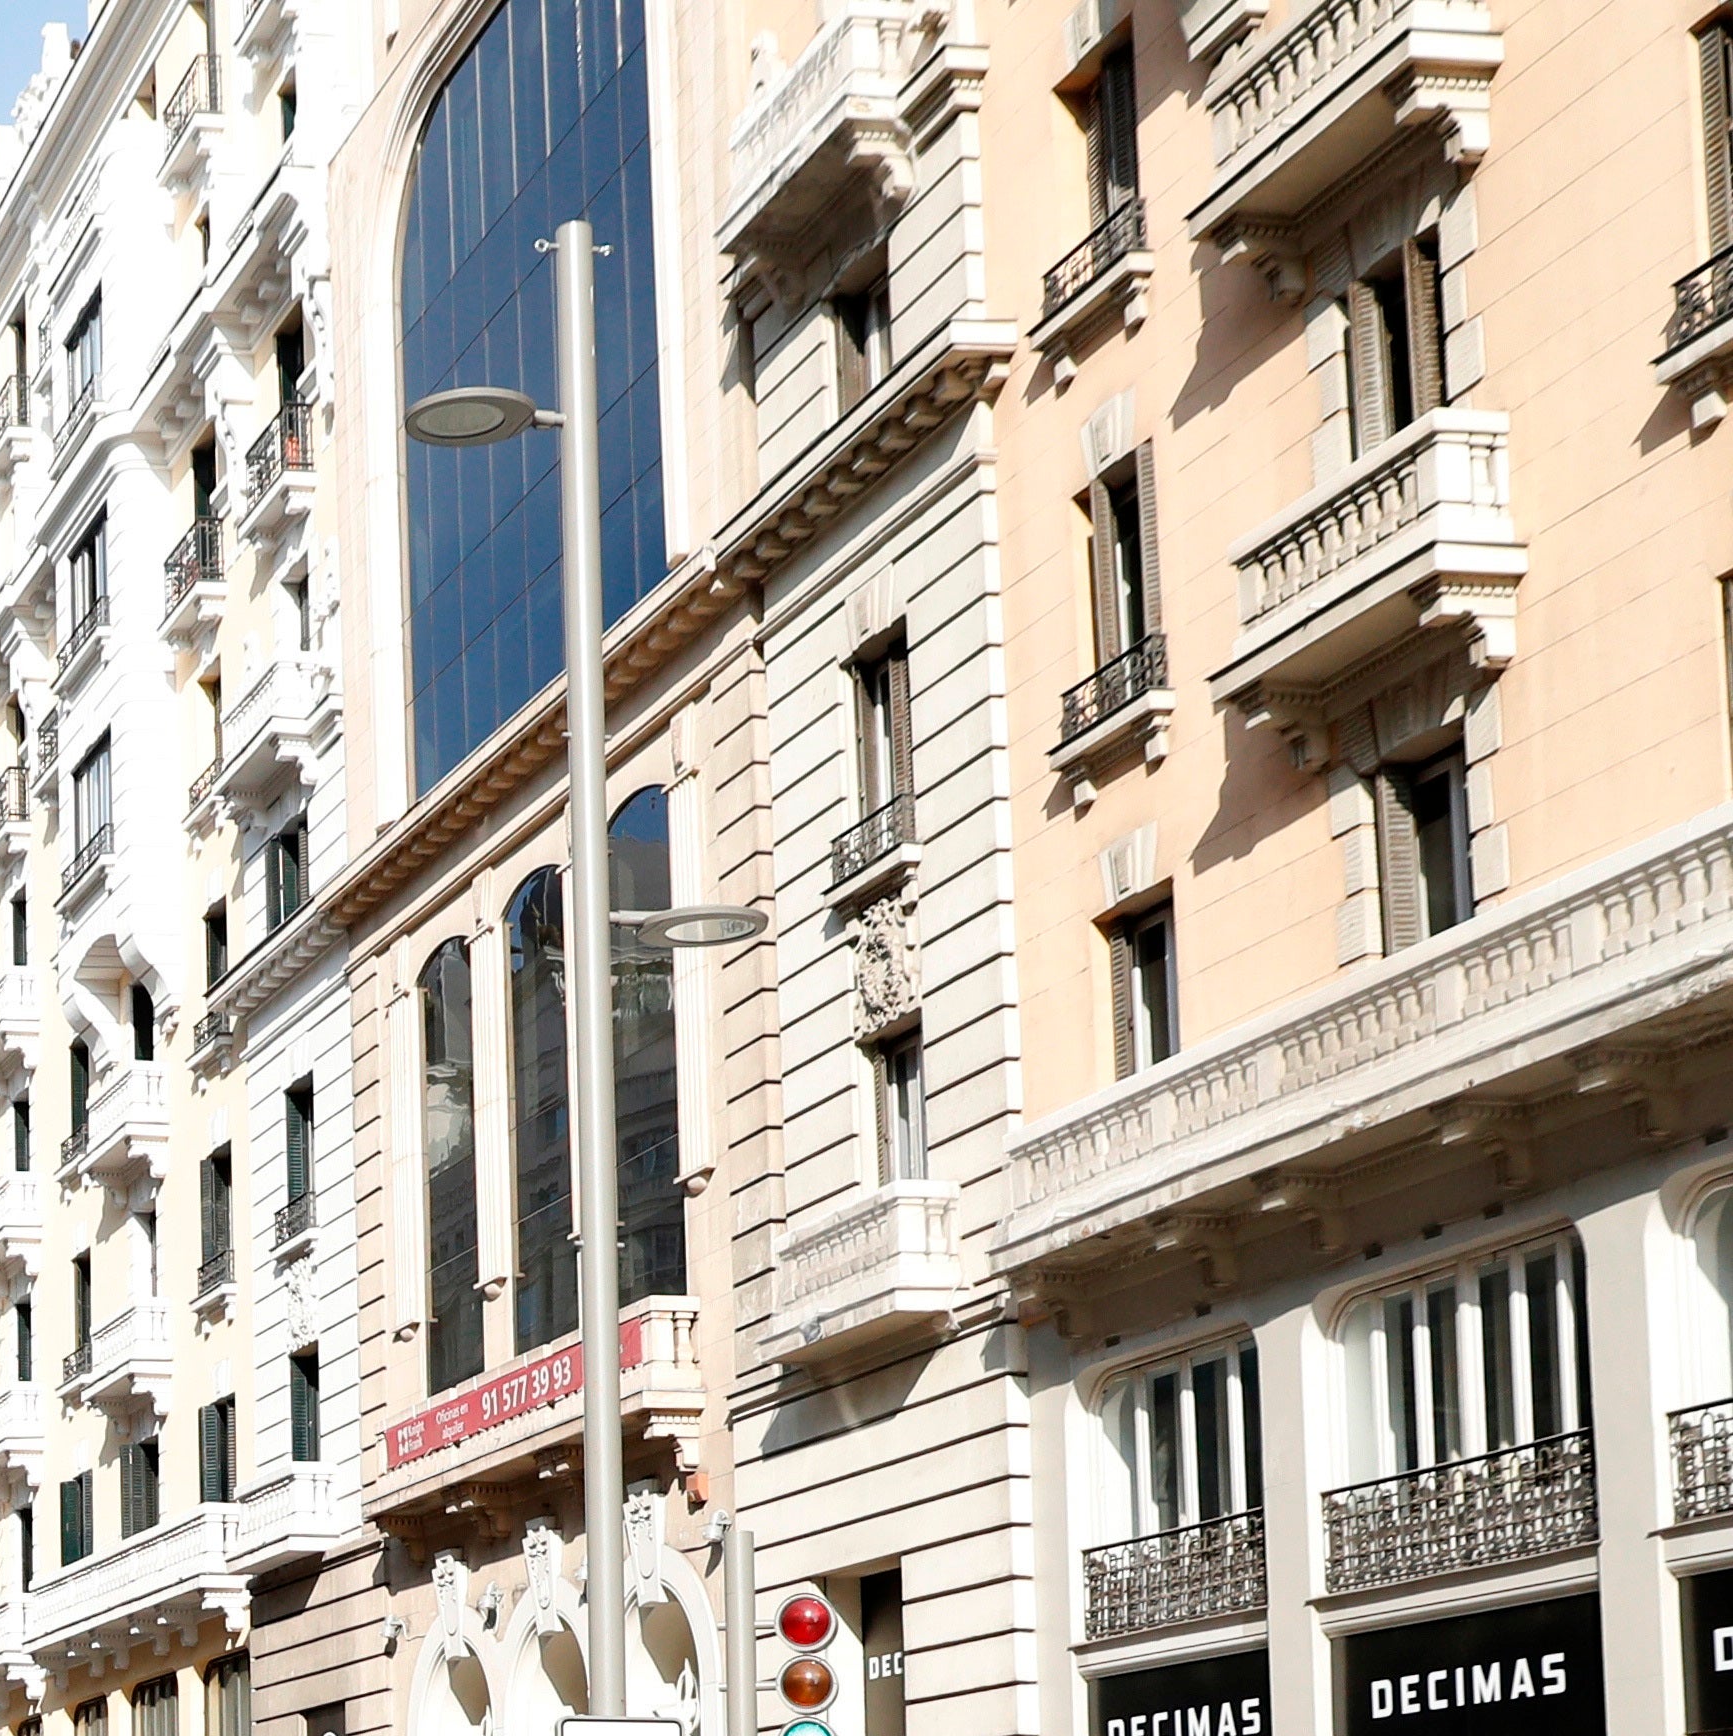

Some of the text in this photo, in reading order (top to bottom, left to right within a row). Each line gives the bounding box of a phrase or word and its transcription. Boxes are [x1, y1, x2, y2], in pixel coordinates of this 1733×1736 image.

[481, 1354, 572, 1421] 91 577 39 93
[436, 1401, 469, 1425] Oficinas en
[441, 1419, 465, 1442] alquiler
[1370, 1652, 1567, 1720] DECIMAS
